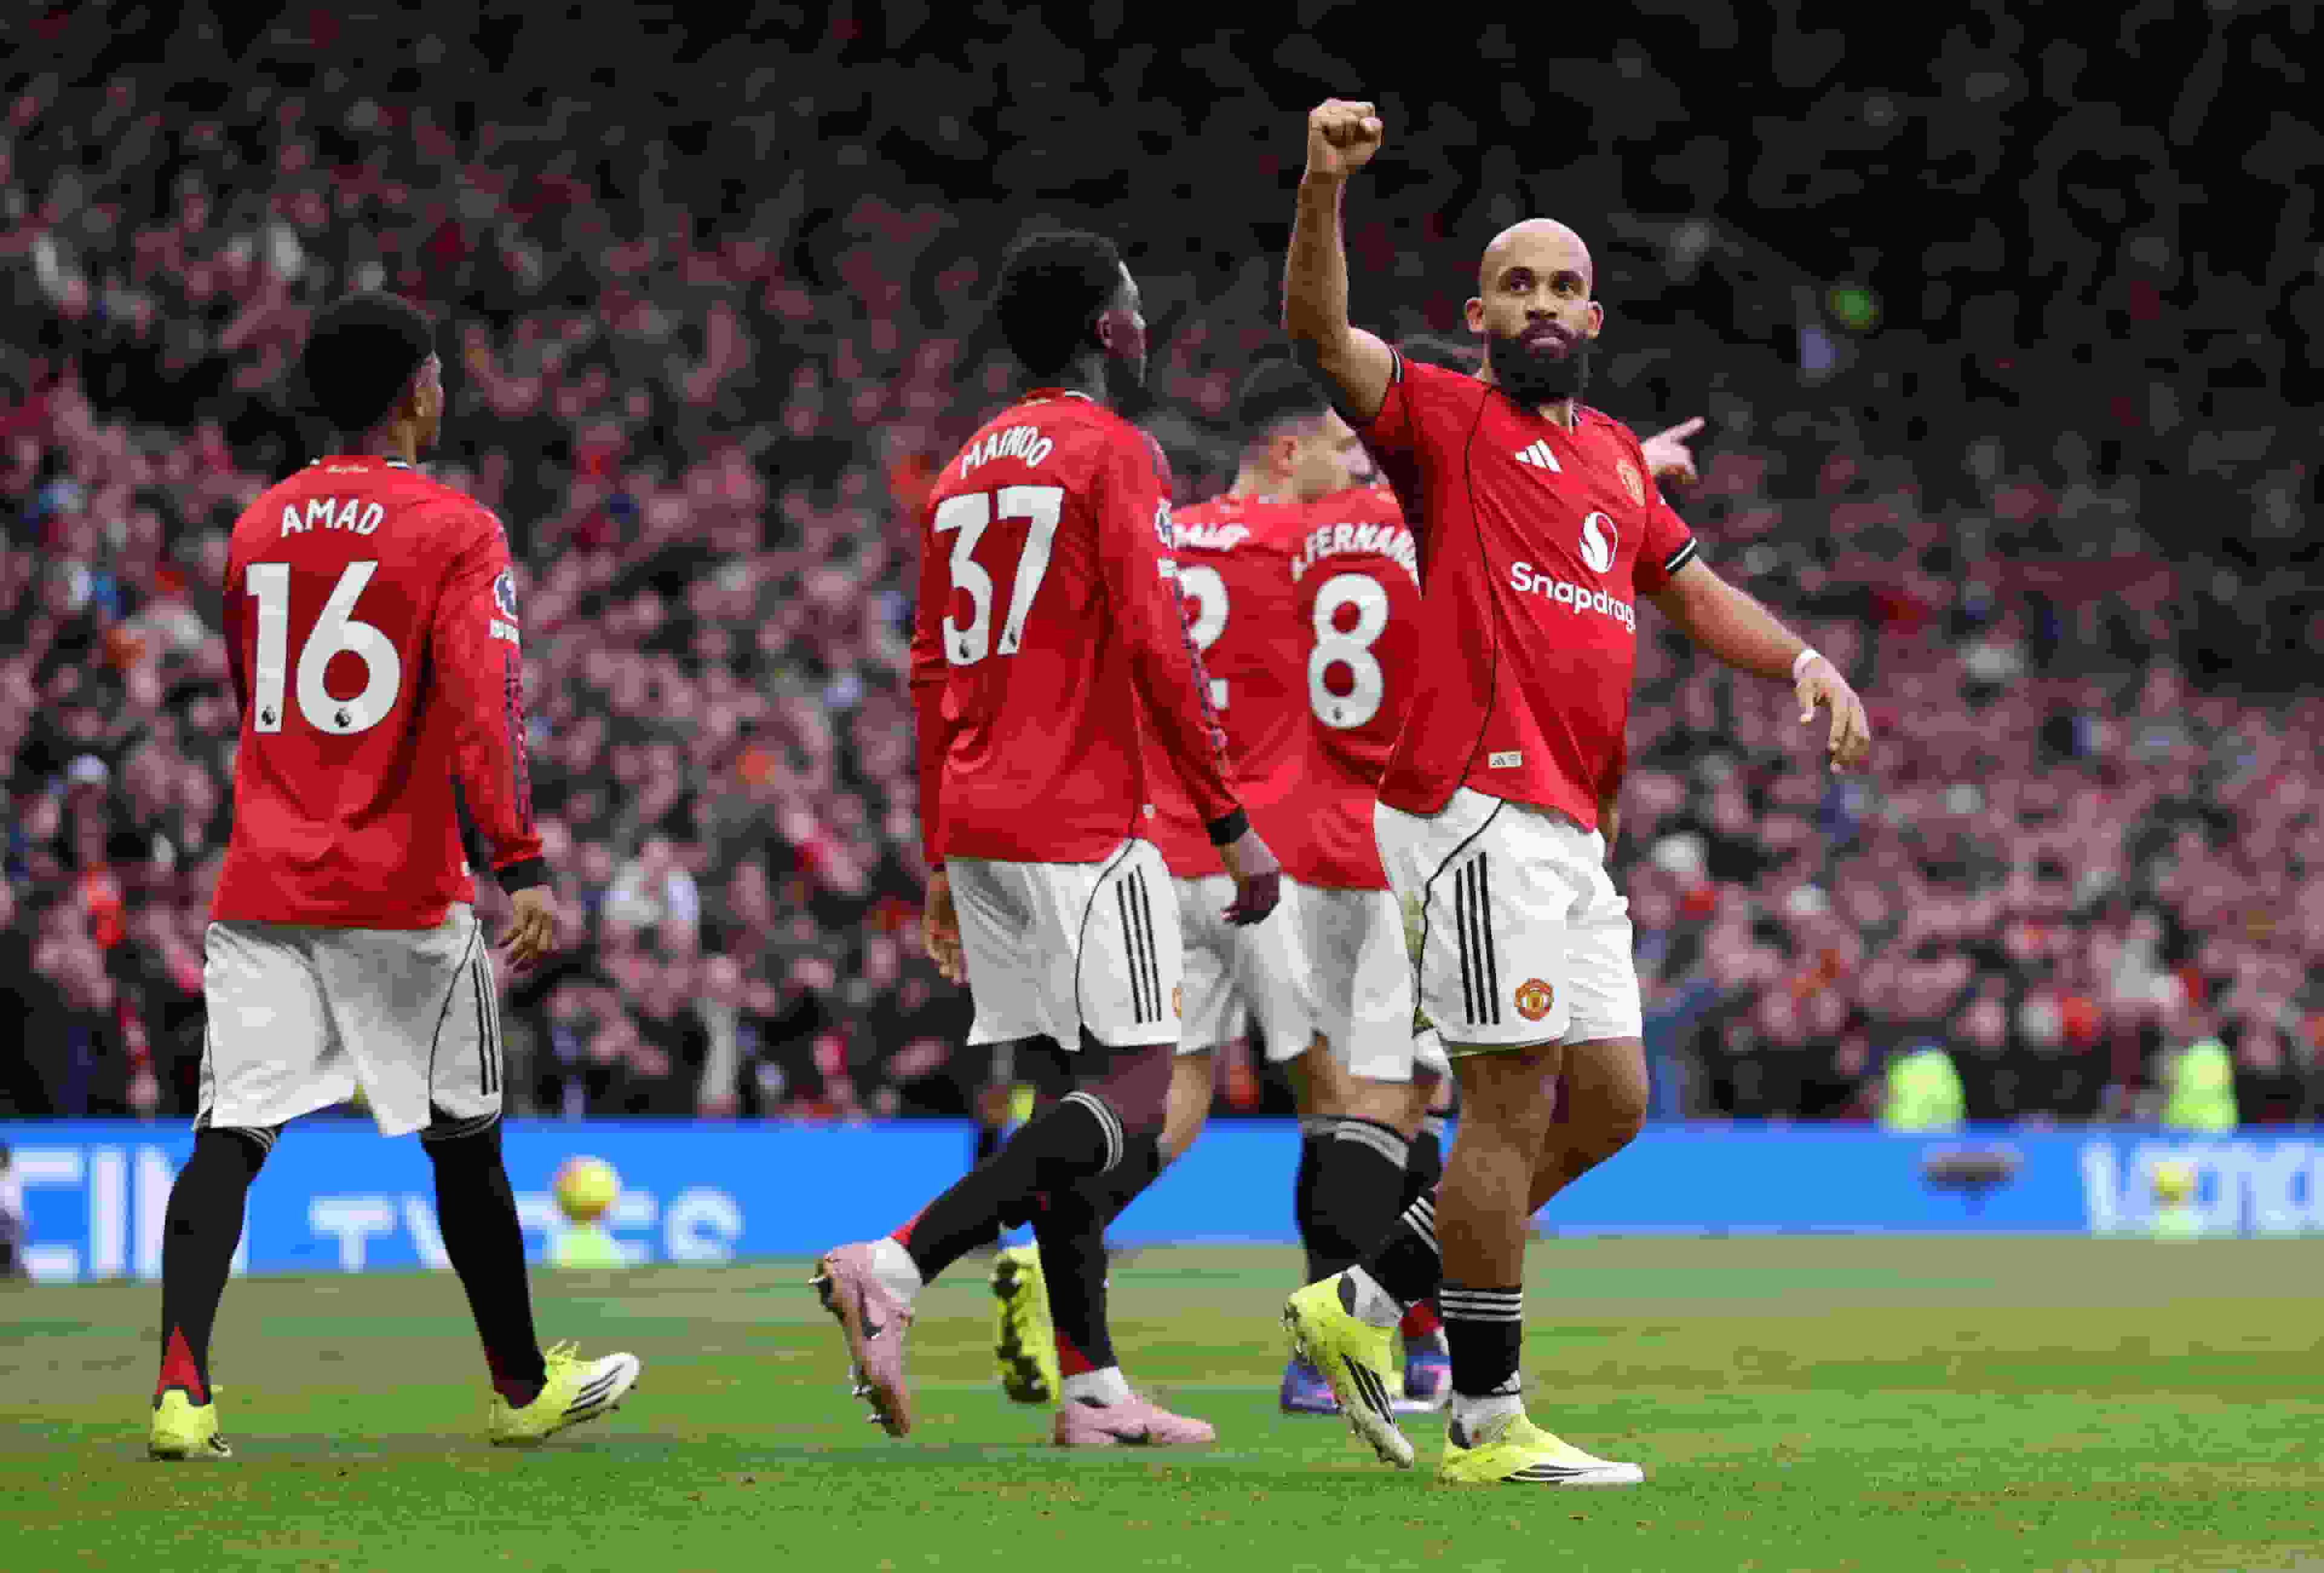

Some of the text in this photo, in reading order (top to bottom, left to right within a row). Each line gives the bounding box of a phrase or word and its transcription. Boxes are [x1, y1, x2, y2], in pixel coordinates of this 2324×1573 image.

[281, 498, 384, 537] AMAD
[960, 425, 1054, 479] MAINOO
[246, 561, 401, 734] 16
[934, 485, 1064, 665] 37
[1308, 572, 1388, 729] 8
